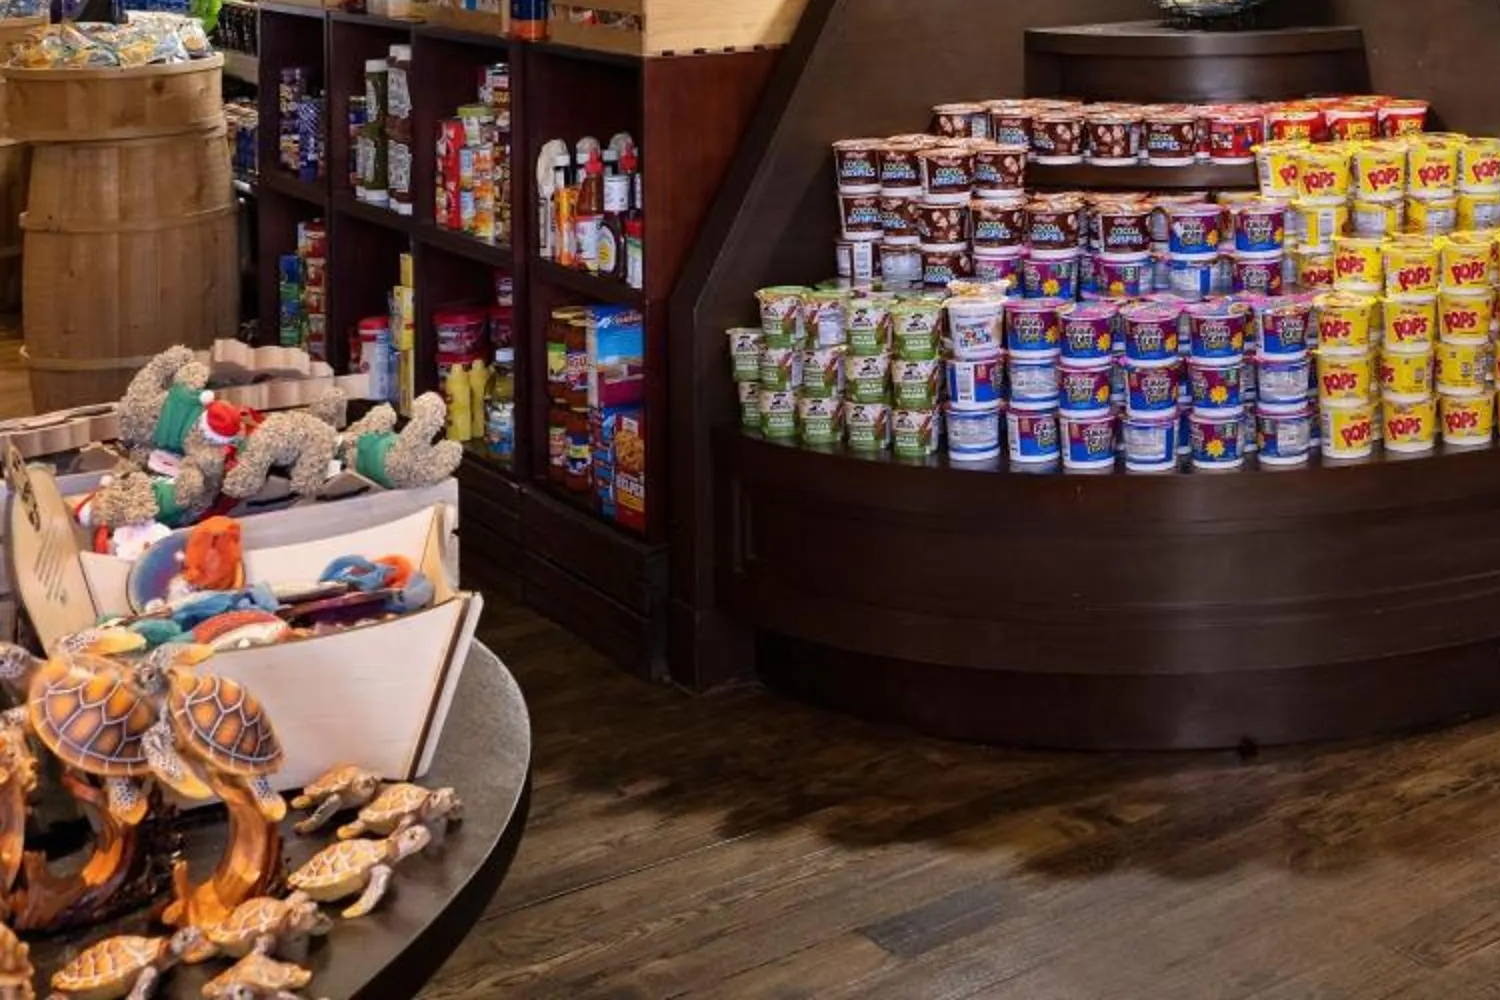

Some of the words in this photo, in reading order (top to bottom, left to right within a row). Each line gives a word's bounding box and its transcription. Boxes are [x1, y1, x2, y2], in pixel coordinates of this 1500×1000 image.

[1279, 165, 1297, 186] PO
[1303, 171, 1336, 193] POPS
[1367, 167, 1401, 190] POPS
[1417, 165, 1451, 187] POPS
[1335, 256, 1366, 278] POPS
[1450, 261, 1486, 282] POPS
[1397, 267, 1432, 291] POPS
[1393, 317, 1428, 339] POPS
[1443, 310, 1478, 332] POPS
[1323, 373, 1358, 395] POPS
[1388, 416, 1422, 440] POPS
[1446, 411, 1478, 433] POPS
[1341, 421, 1372, 447] POPS
